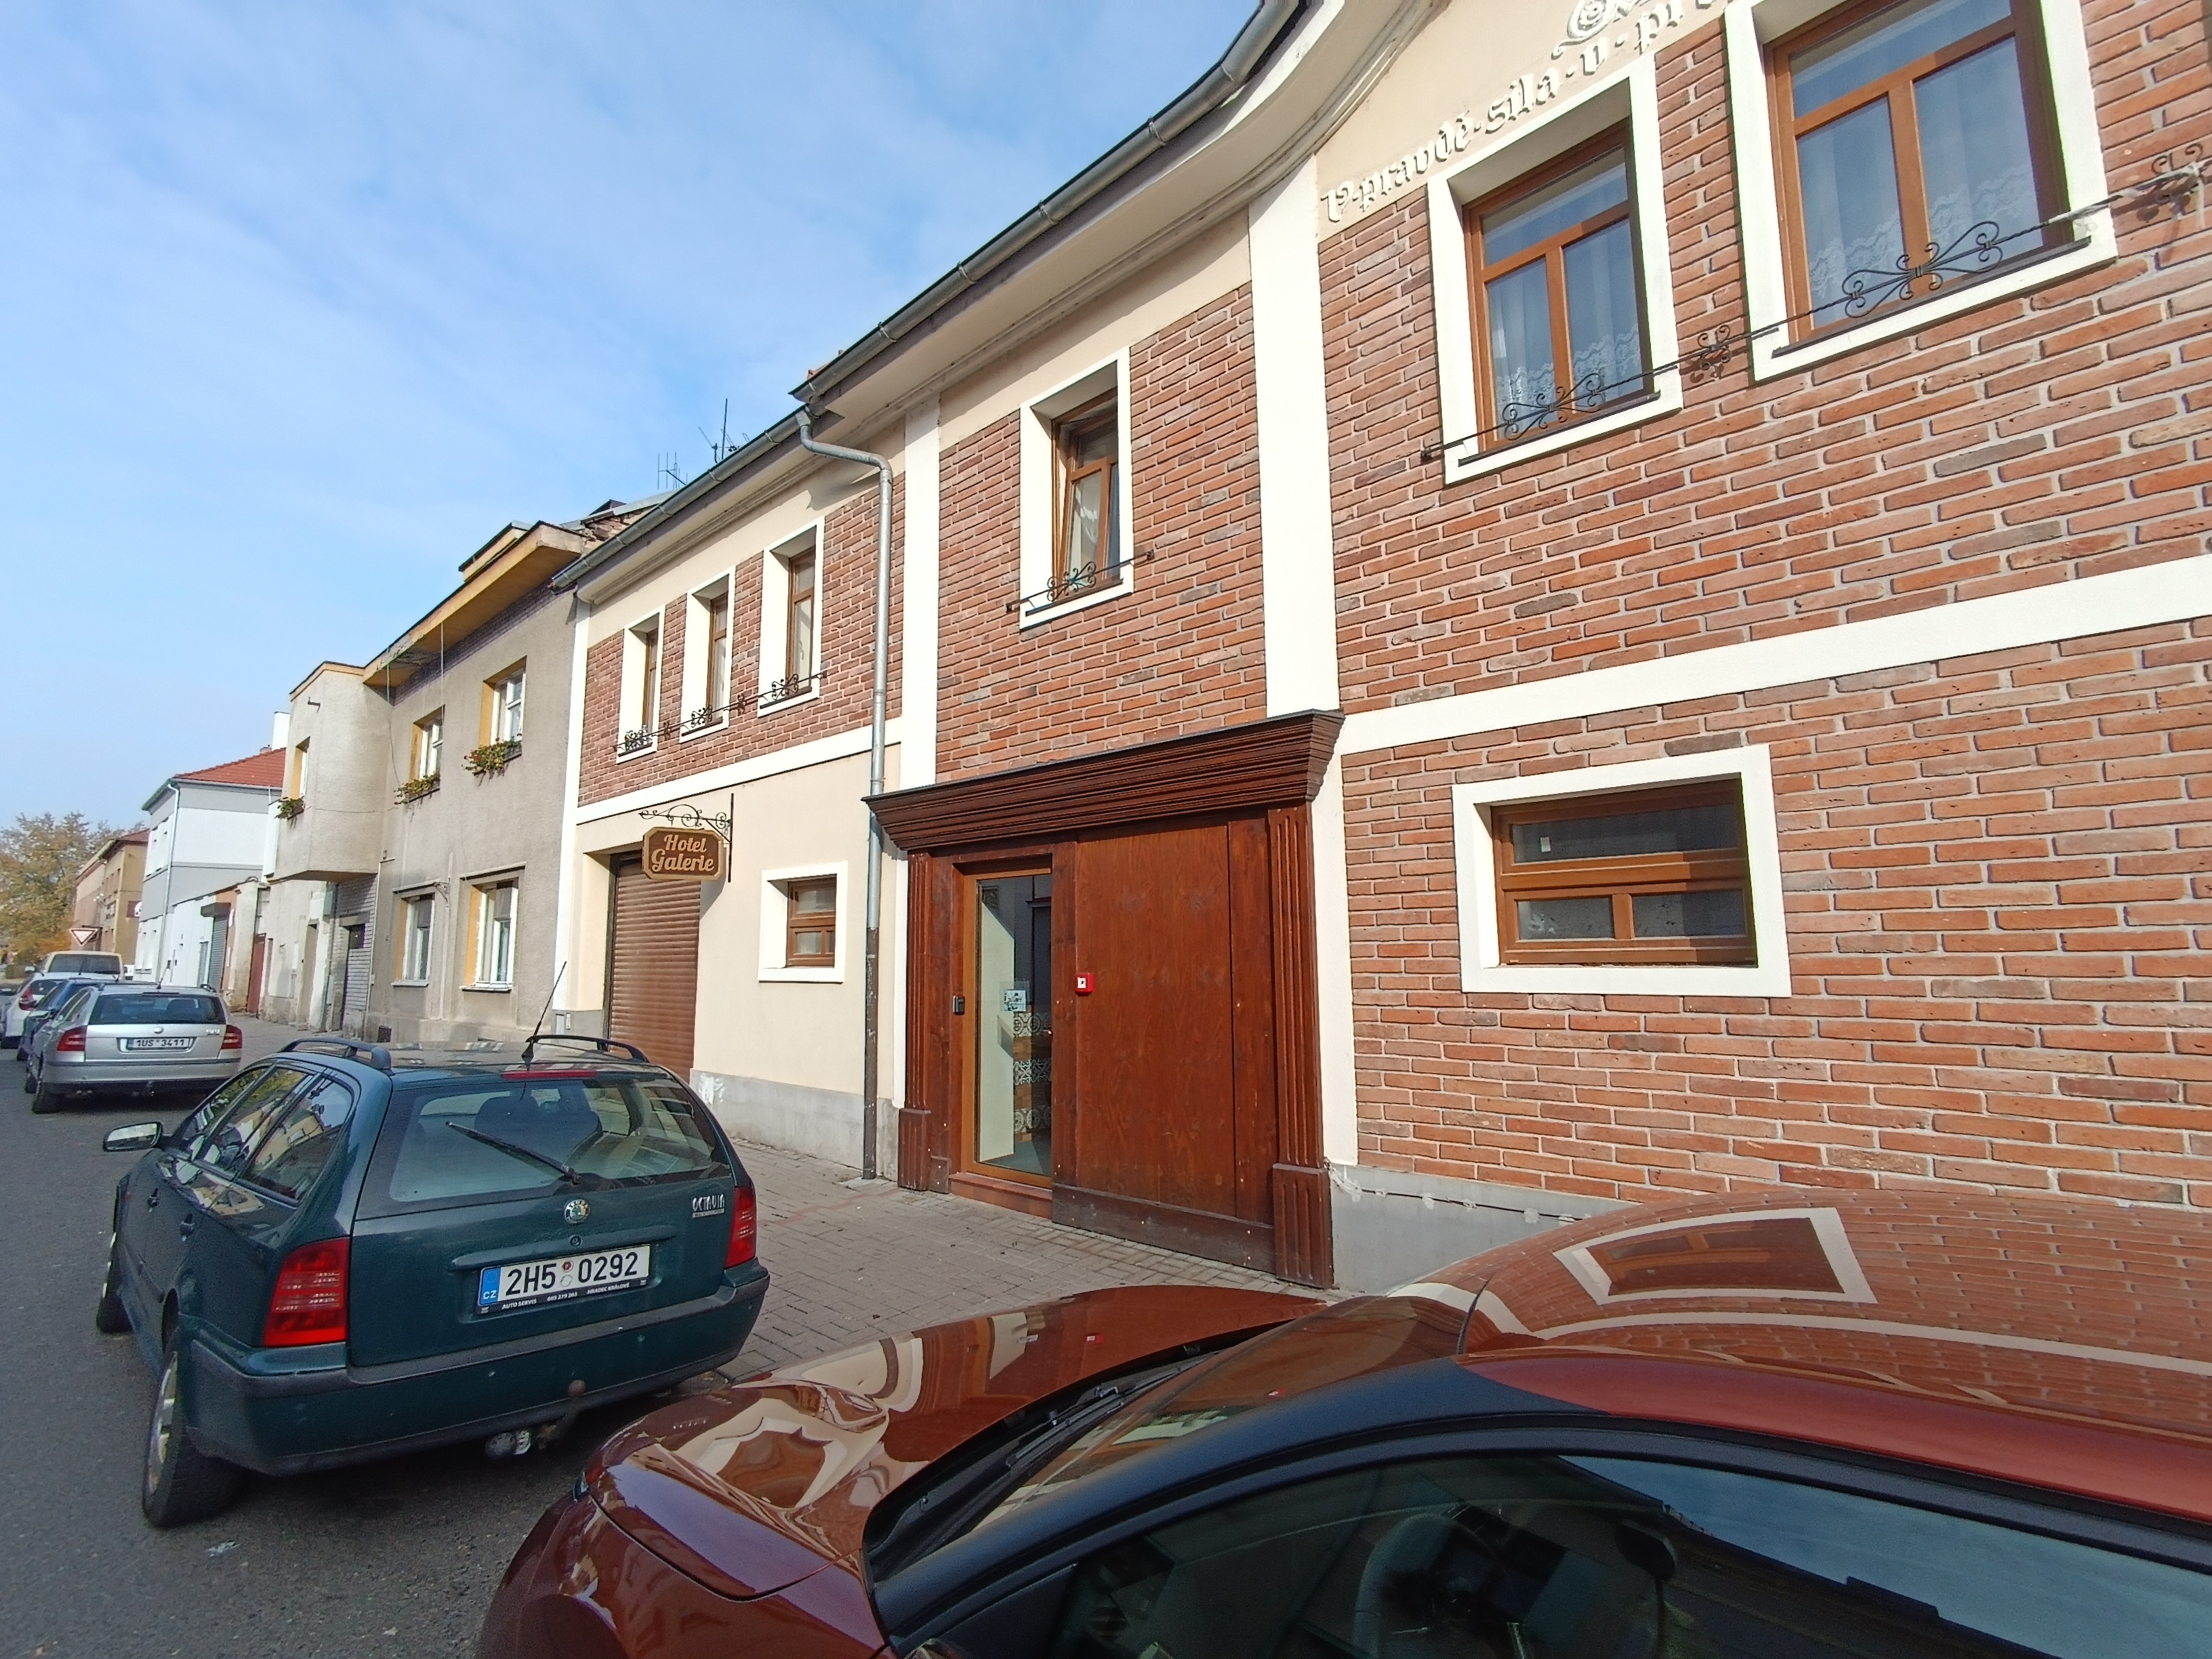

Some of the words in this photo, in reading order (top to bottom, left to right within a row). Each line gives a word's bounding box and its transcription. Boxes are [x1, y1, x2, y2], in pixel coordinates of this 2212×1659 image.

[664, 834, 707, 853] Hotel
[651, 848, 714, 872] Galerie
[692, 1193, 725, 1212] OCTAVIA
[506, 1263, 556, 1296] 2H5
[578, 1252, 638, 1283] 0292
[483, 1290, 496, 1299] CZ
[518, 1298, 537, 1307] SERVIS
[587, 1286, 607, 1294] HRADEC
